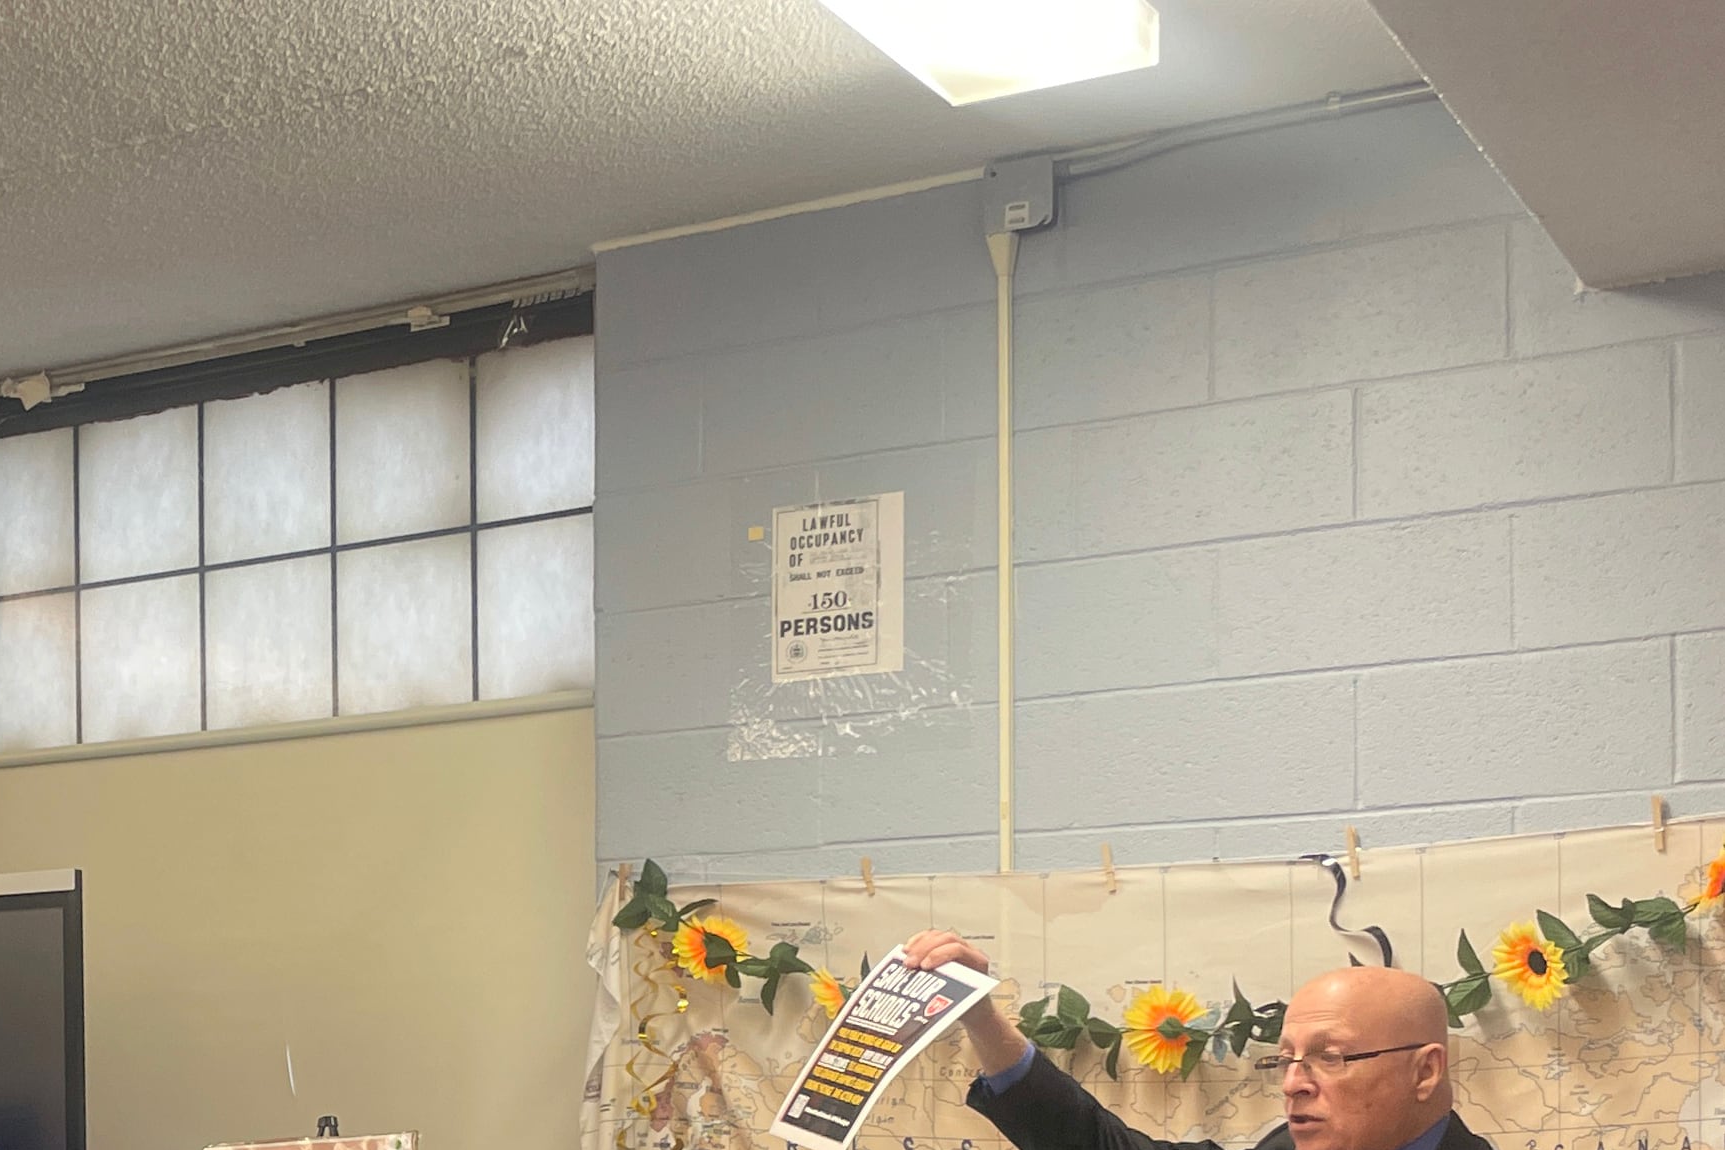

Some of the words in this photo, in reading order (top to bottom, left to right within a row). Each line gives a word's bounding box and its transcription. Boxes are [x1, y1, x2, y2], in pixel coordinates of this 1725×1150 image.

[802, 513, 851, 532] LAWFUL
[789, 528, 864, 550] OCCUPANCY
[789, 553, 803, 568] OF
[789, 573, 812, 582] SHALL
[816, 570, 831, 578] NOT
[835, 566, 864, 576] EXCEED
[780, 611, 874, 638] PERSONS
[873, 963, 916, 992] SAVE
[901, 970, 947, 1002] OUR
[851, 988, 921, 1029] SCHOOLS
